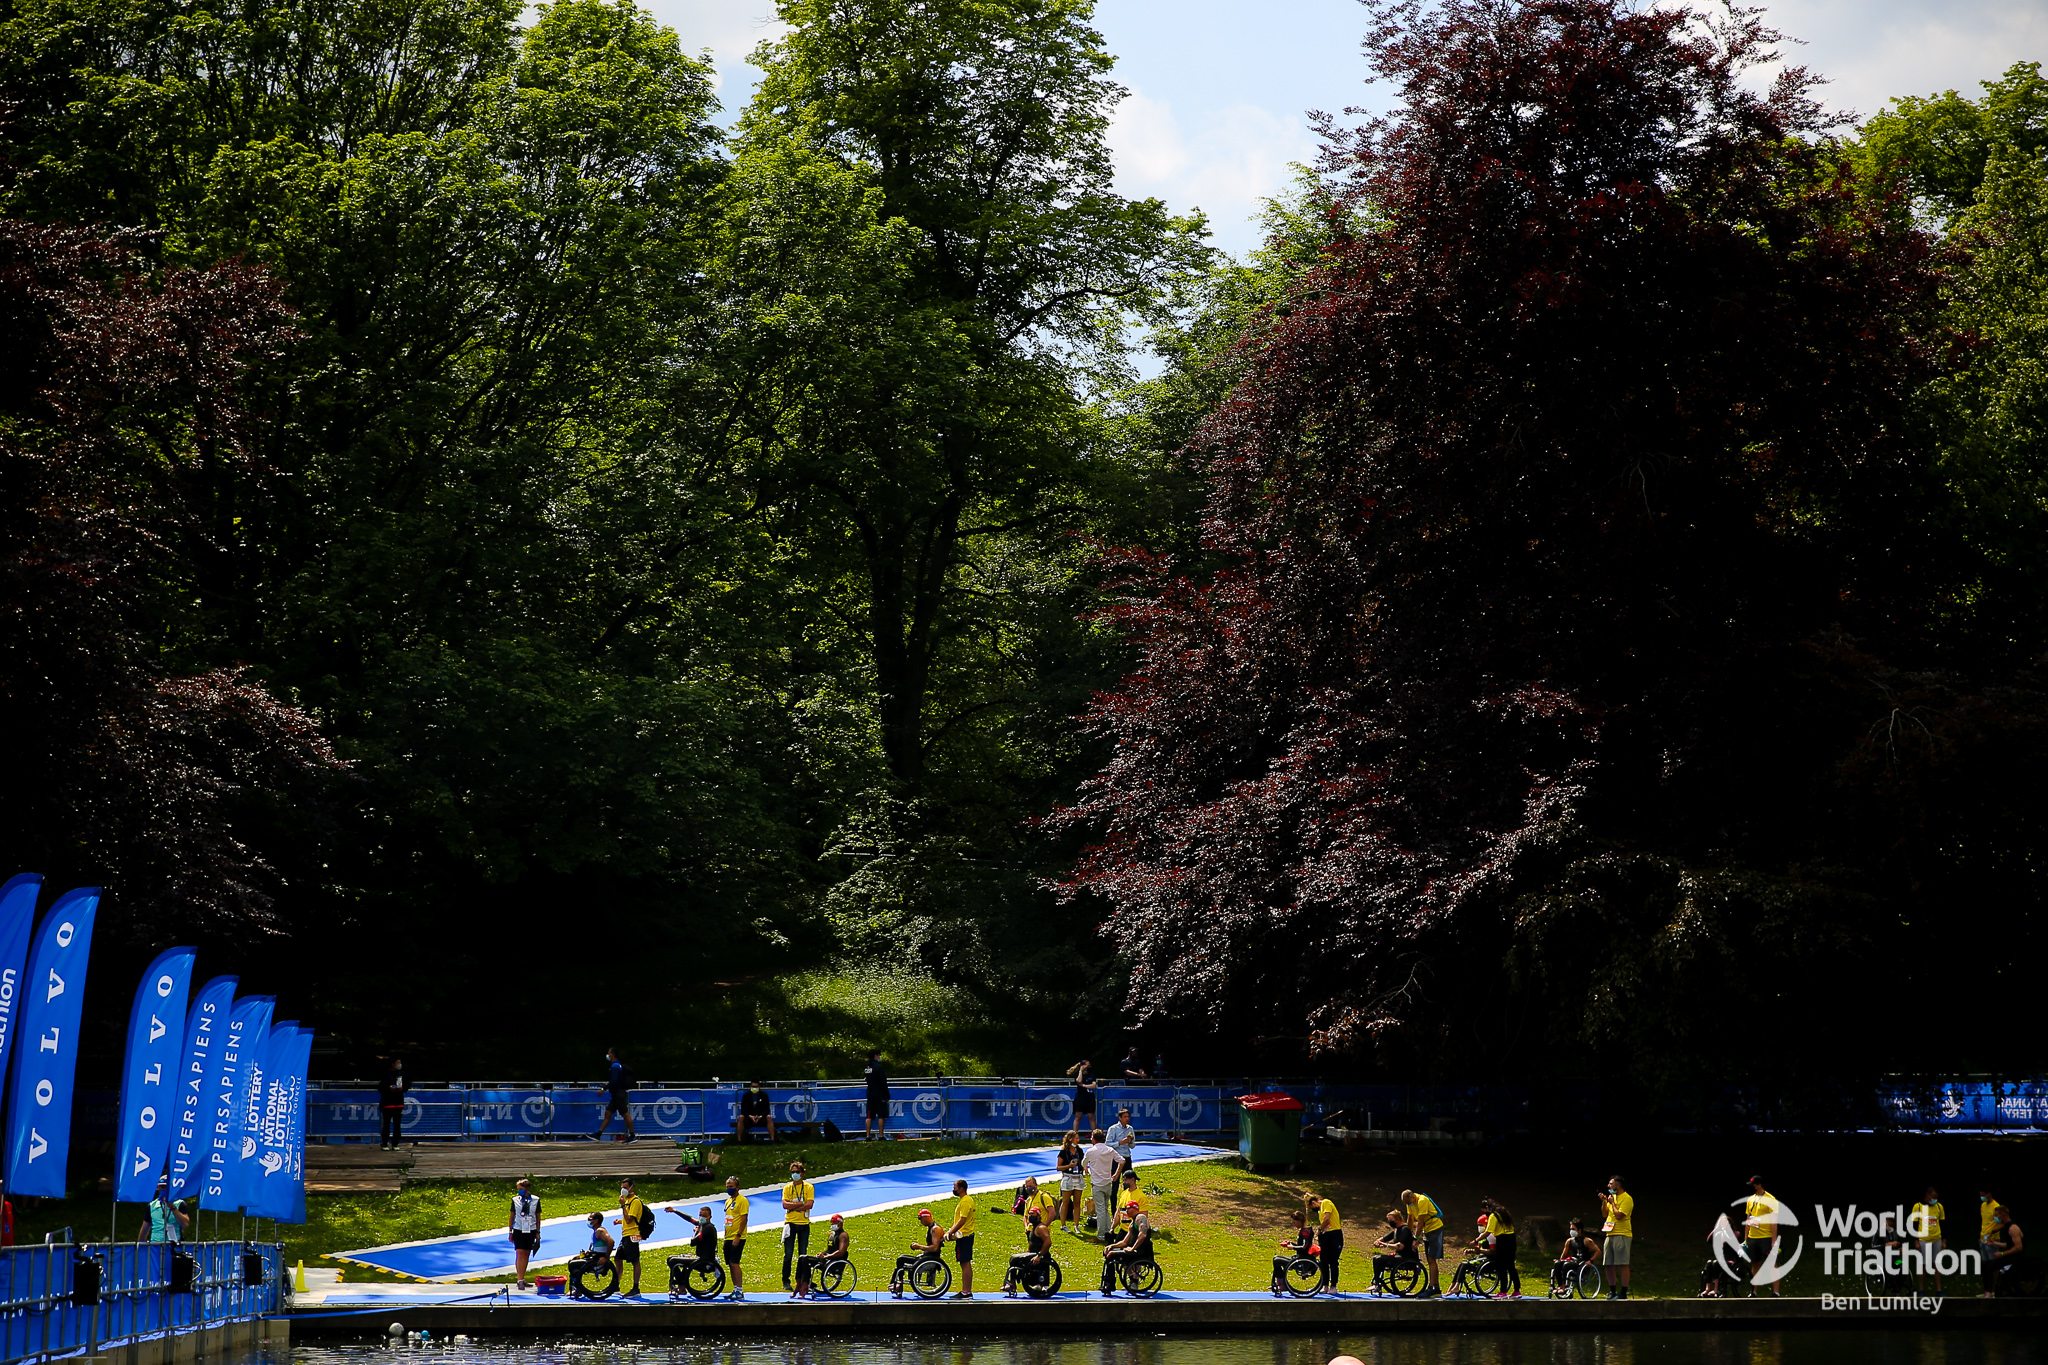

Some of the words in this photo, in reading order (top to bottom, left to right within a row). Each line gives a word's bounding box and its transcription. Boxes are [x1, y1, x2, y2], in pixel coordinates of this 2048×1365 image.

[28, 921, 75, 1164] VOLVO
[133, 974, 175, 1177] VOLVO
[172, 1001, 216, 1188] SUPERSAPIENS
[209, 1020, 244, 1196] SUPERSAPIENS
[247, 1065, 263, 1132] LOTTERY
[264, 1078, 279, 1146] NATIONAL
[274, 1085, 289, 1148] LOTTERY
